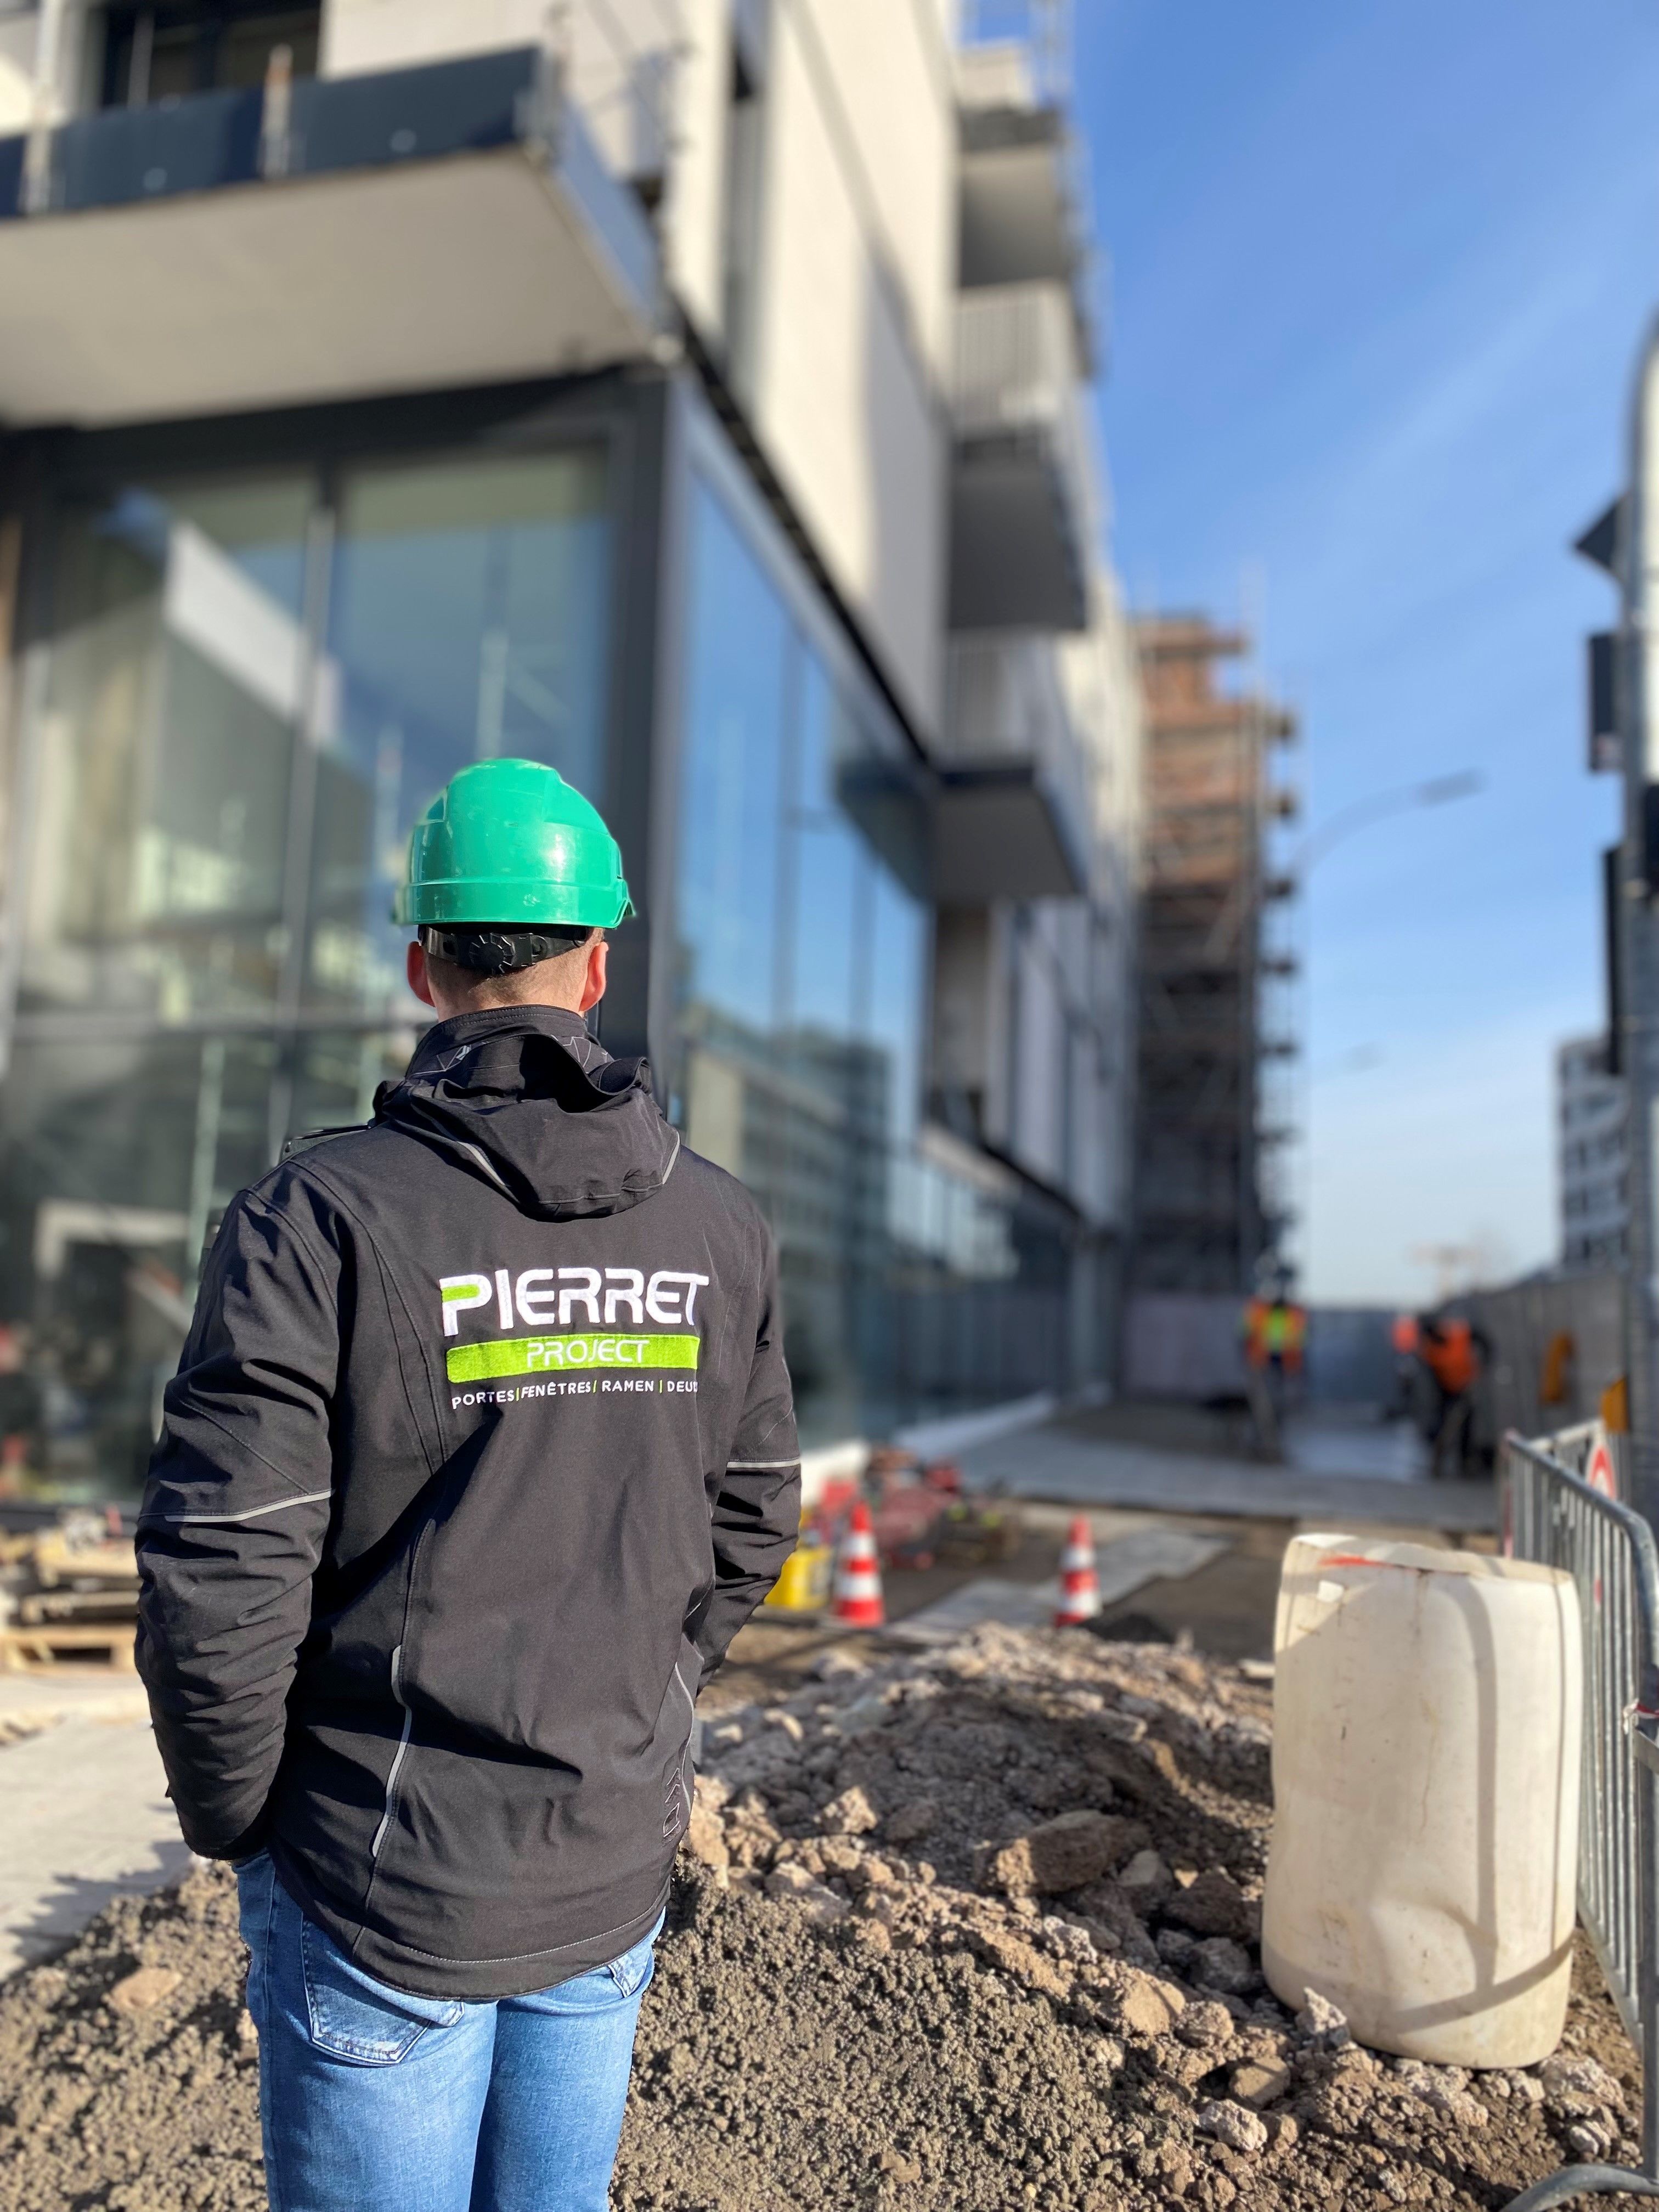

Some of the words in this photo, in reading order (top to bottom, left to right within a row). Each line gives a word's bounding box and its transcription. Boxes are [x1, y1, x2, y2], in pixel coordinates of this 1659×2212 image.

[439, 1267, 709, 1336] PIERRET
[527, 1339, 650, 1368] PROJECT
[452, 1389, 515, 1409] PORTES
[521, 1381, 591, 1399] FENÊTRES
[602, 1380, 654, 1392] RAMEN
